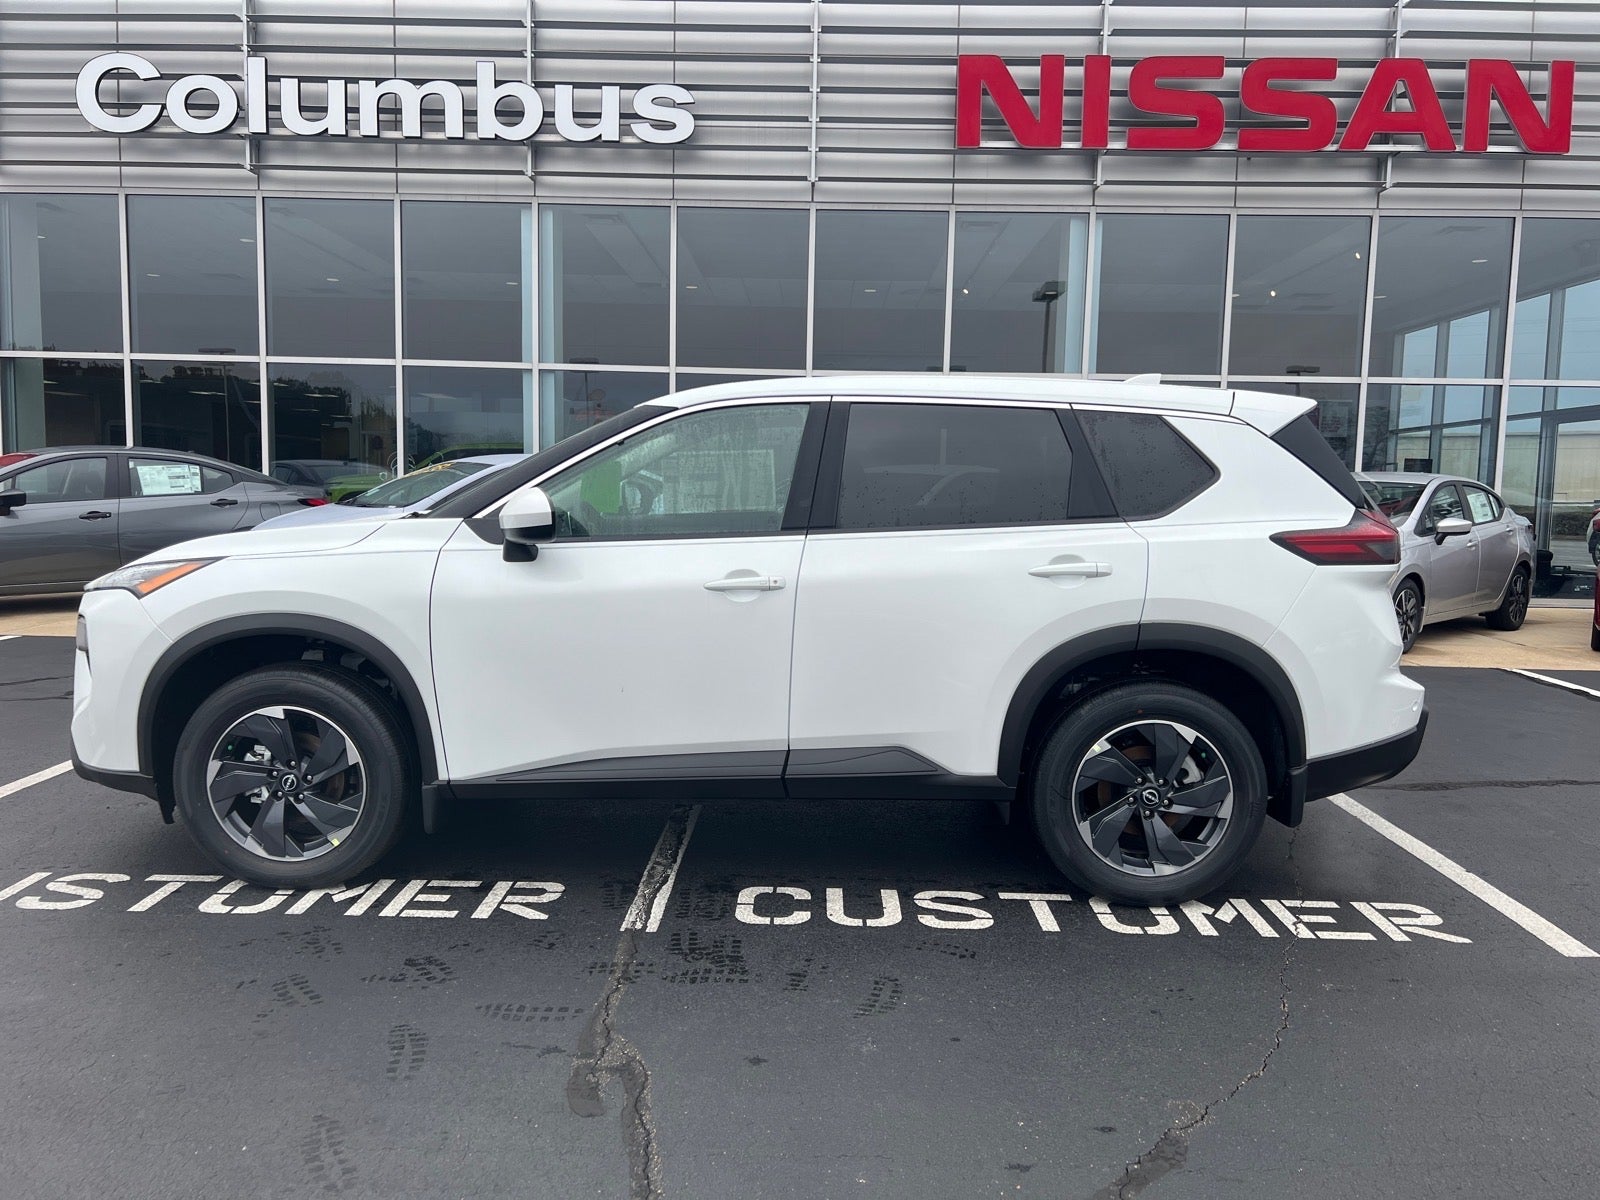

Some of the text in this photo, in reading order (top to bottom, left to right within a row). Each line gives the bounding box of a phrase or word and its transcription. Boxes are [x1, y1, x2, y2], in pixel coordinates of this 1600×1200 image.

[75, 52, 696, 144] Columbus
[955, 54, 1576, 155] NISSAN
[0, 872, 566, 920] STOMER
[734, 886, 1473, 944] CUSTOMER
